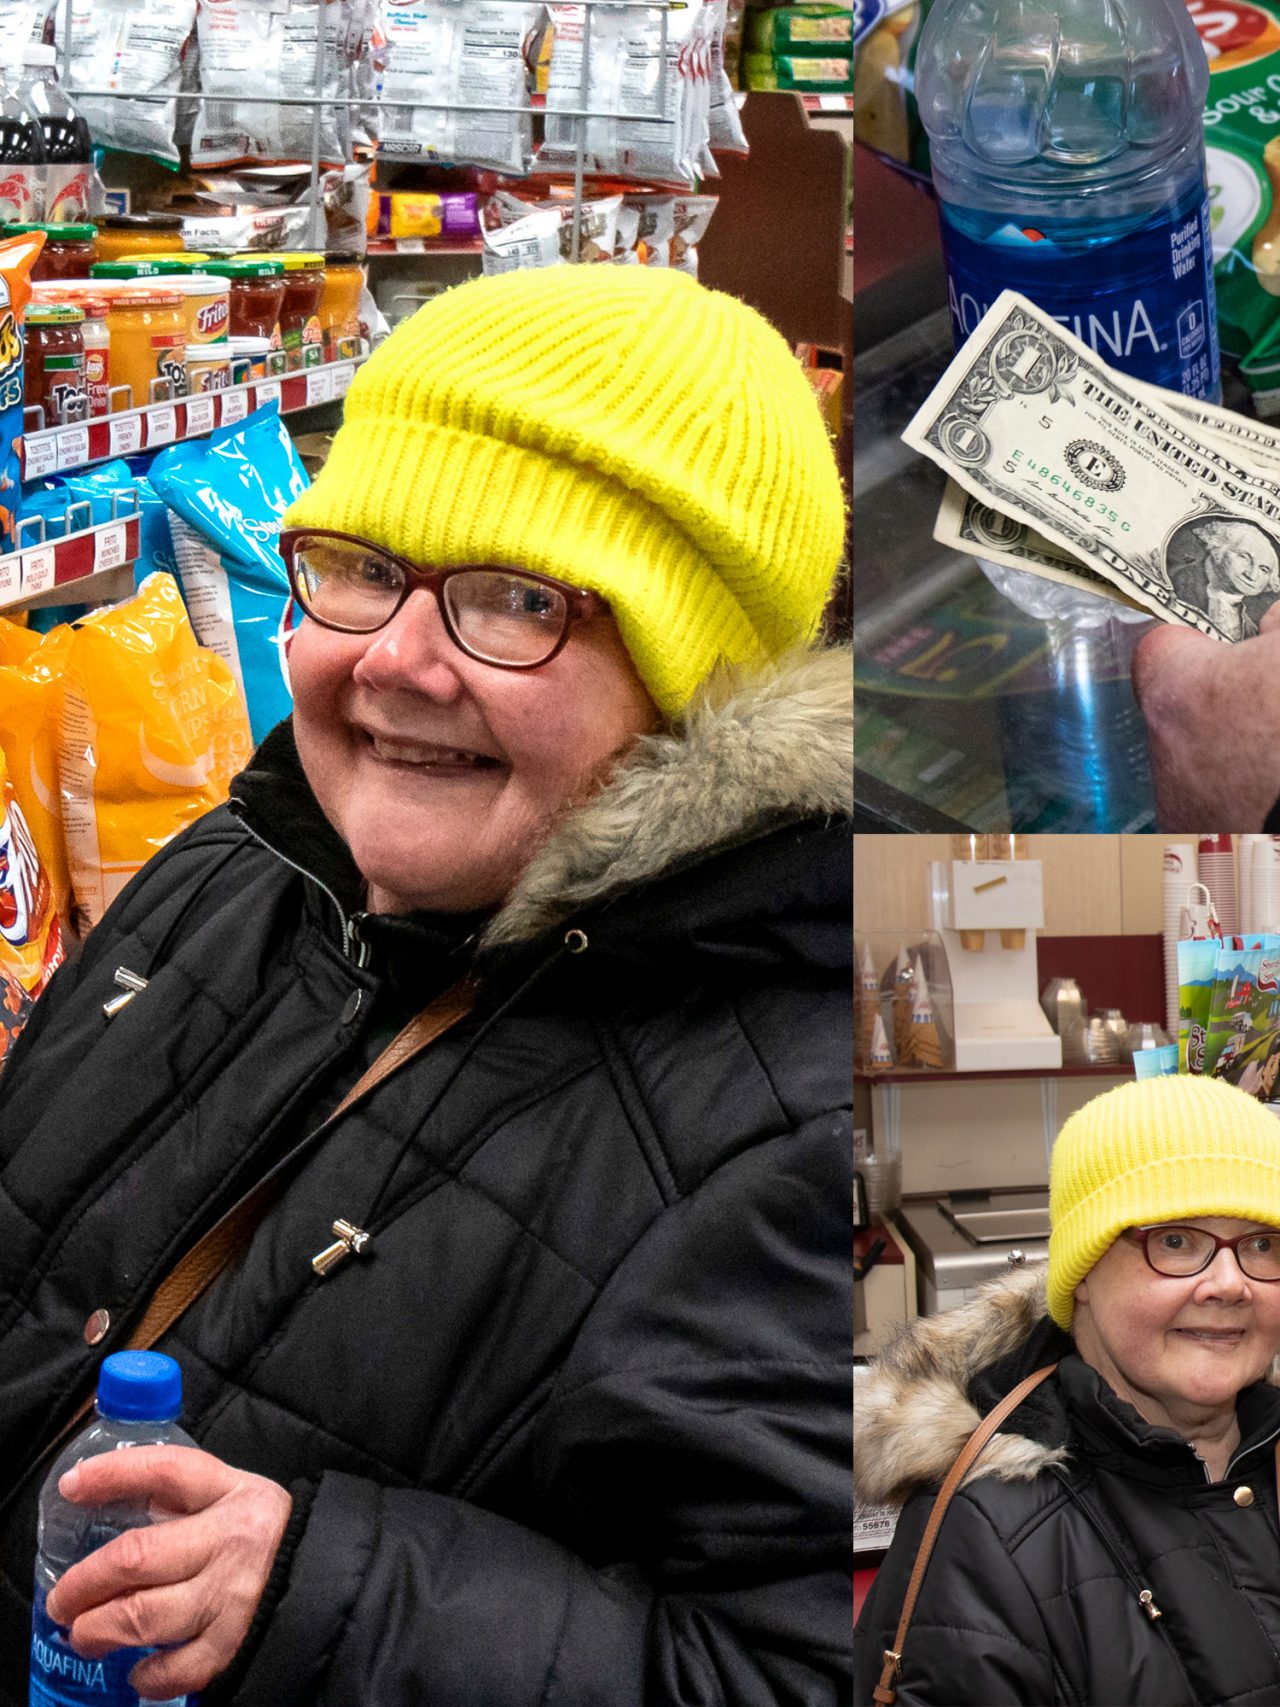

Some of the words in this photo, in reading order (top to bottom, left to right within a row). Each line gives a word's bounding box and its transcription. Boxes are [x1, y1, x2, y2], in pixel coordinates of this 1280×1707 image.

[1200, 85, 1266, 126] Sour
[383, 143, 420, 153] NASCAR
[194, 228, 220, 236] Facts
[1171, 215, 1198, 248] Purified
[1172, 233, 1201, 264] Drinking
[137, 267, 159, 275] MILD
[258, 267, 276, 275] MILD
[1173, 255, 1196, 280] Water
[1189, 312, 1196, 331] 0
[1039, 415, 1053, 430] 5
[1083, 379, 1131, 426] THE
[1134, 419, 1220, 485] UNITED
[1001, 460, 1016, 474] 5
[1083, 454, 1107, 480] E
[863, 1520, 890, 1530] 55678
[31, 1633, 107, 1693] AQUAFINA
